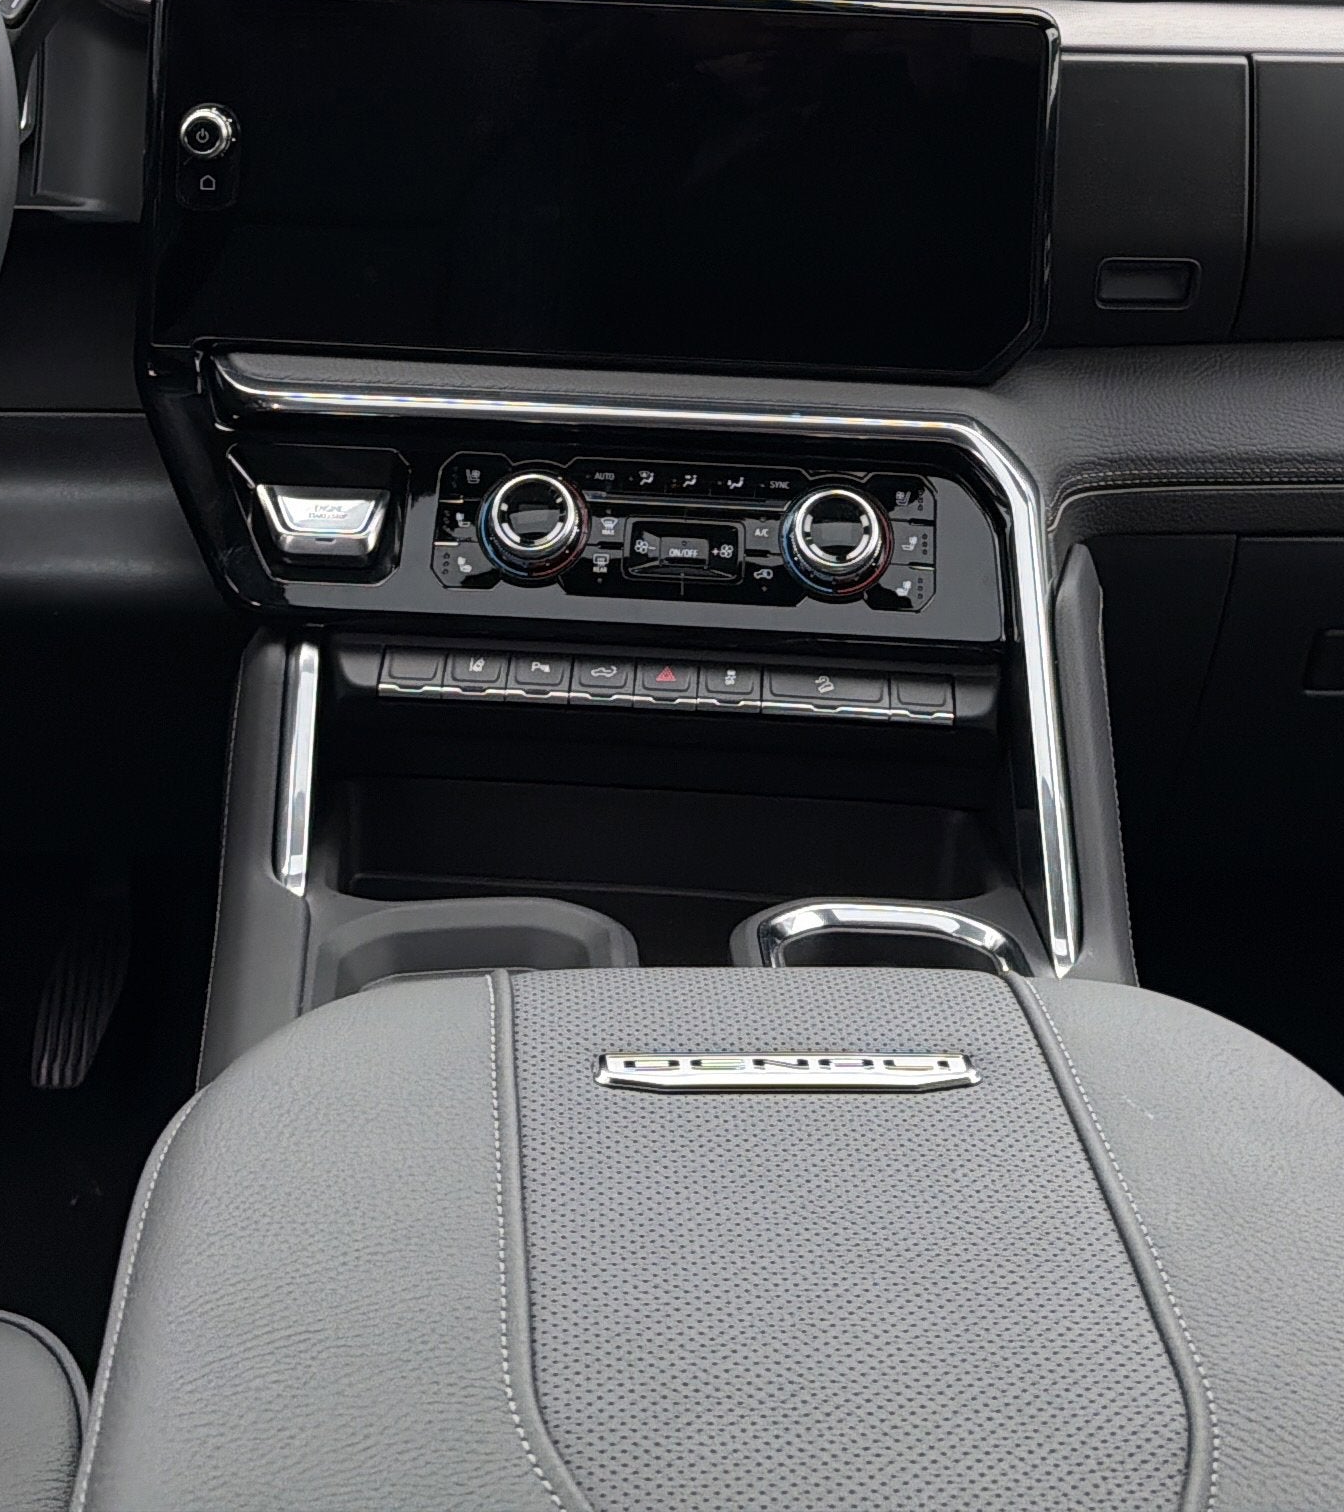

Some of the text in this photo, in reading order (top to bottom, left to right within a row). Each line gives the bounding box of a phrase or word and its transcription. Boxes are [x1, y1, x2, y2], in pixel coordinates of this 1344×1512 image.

[594, 472, 615, 481] AUTO
[769, 480, 790, 489] SYNC
[754, 528, 769, 537] A/C
[668, 549, 699, 558] ON/OFF
[622, 1057, 952, 1072] DENALI
